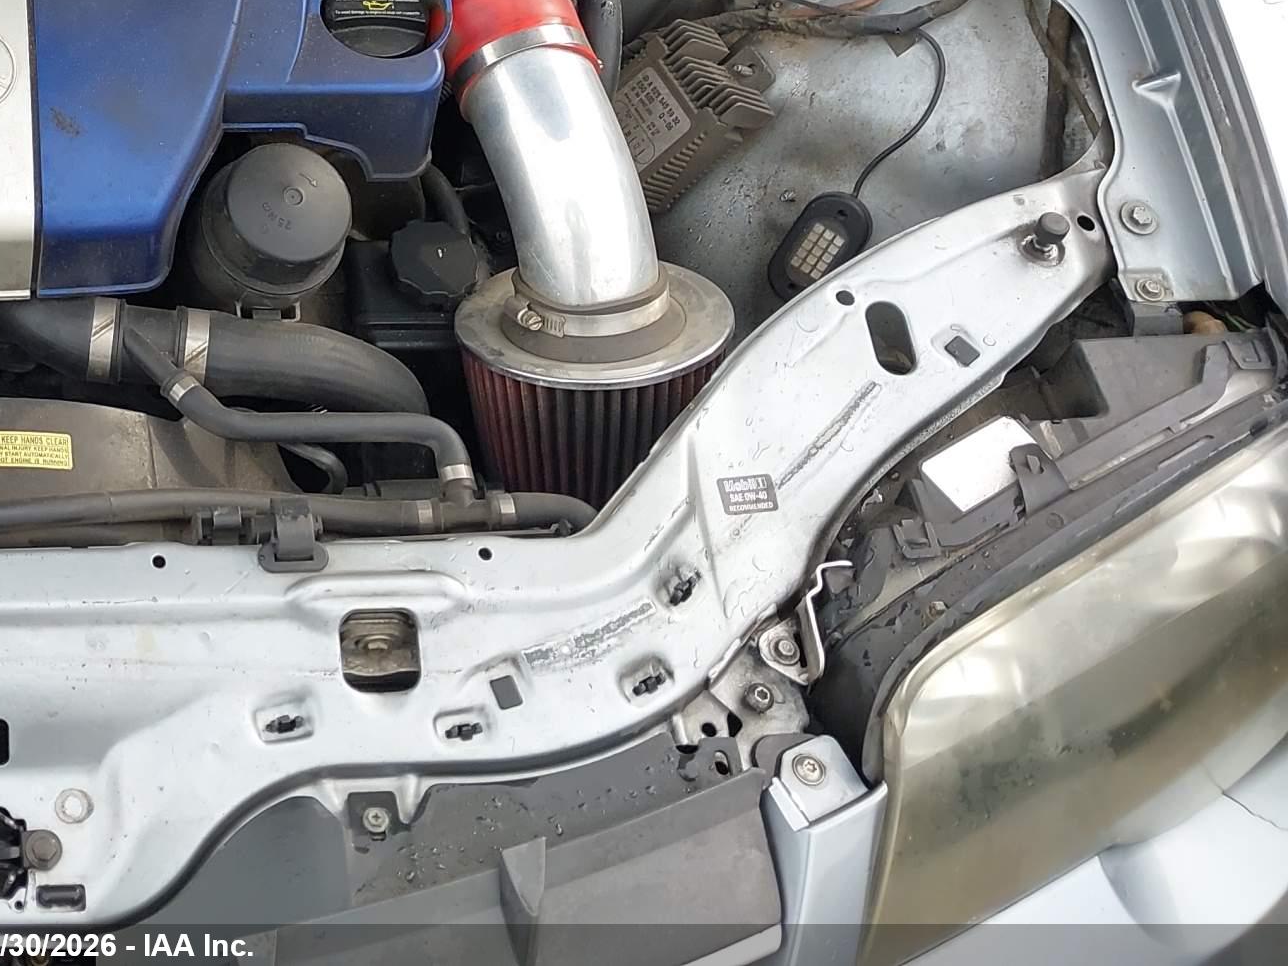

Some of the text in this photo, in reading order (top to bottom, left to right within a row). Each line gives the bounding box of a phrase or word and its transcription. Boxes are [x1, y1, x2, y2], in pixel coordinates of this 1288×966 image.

[1, 435, 18, 444] KEEP
[21, 436, 43, 445] HANDS
[23, 451, 69, 459] AUTOMATICALLY
[729, 490, 768, 502] SAE 0W-40
[728, 501, 774, 511] RECOMMENDED
